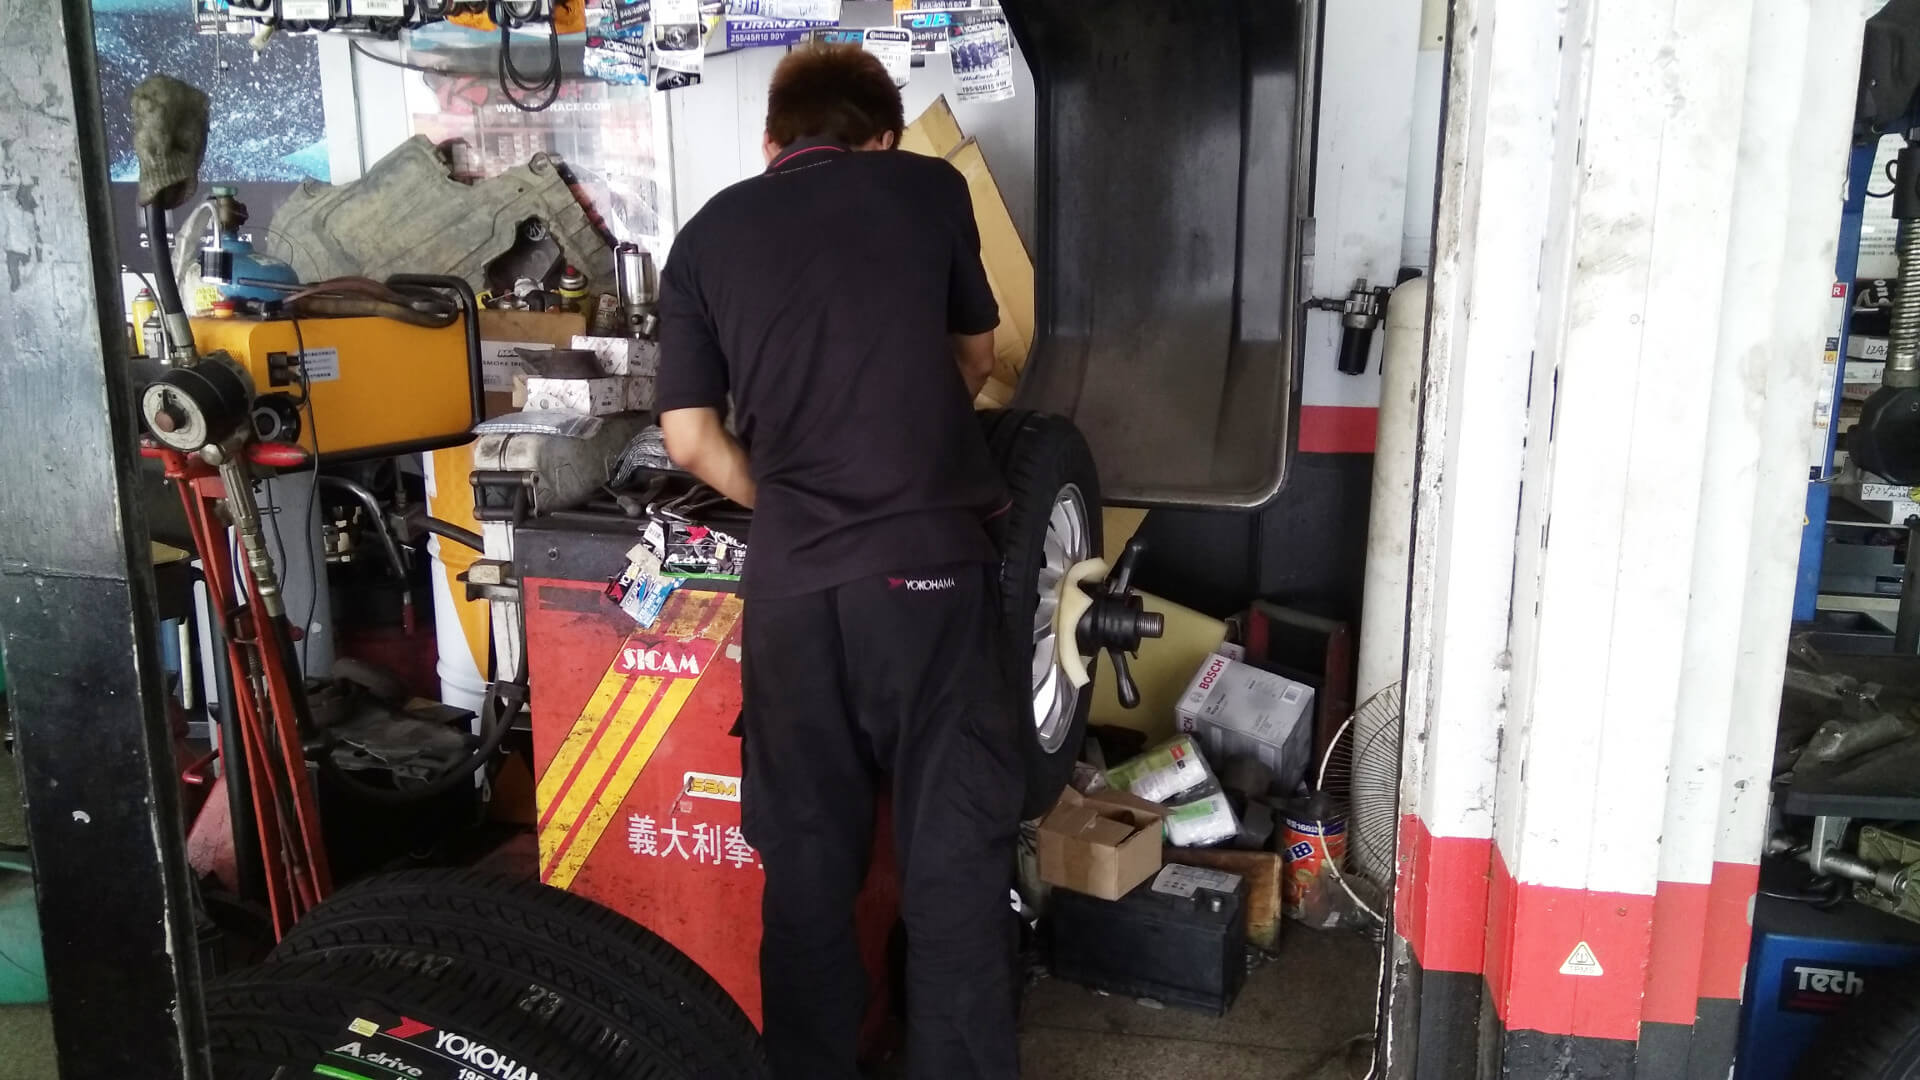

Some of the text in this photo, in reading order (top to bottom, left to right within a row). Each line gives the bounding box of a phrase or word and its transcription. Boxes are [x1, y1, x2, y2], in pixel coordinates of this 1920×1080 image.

[731, 20, 806, 30] TURANZA
[603, 38, 645, 57] YOKOHAMA
[904, 577, 956, 591] YOKOHAMA
[622, 648, 700, 674] SICAM
[1199, 658, 1226, 690] BOSCH
[1183, 716, 1193, 734] SCH
[628, 813, 764, 869] 義大利拳
[1793, 966, 1865, 996] Tech
[333, 1040, 424, 1078] A.drive
